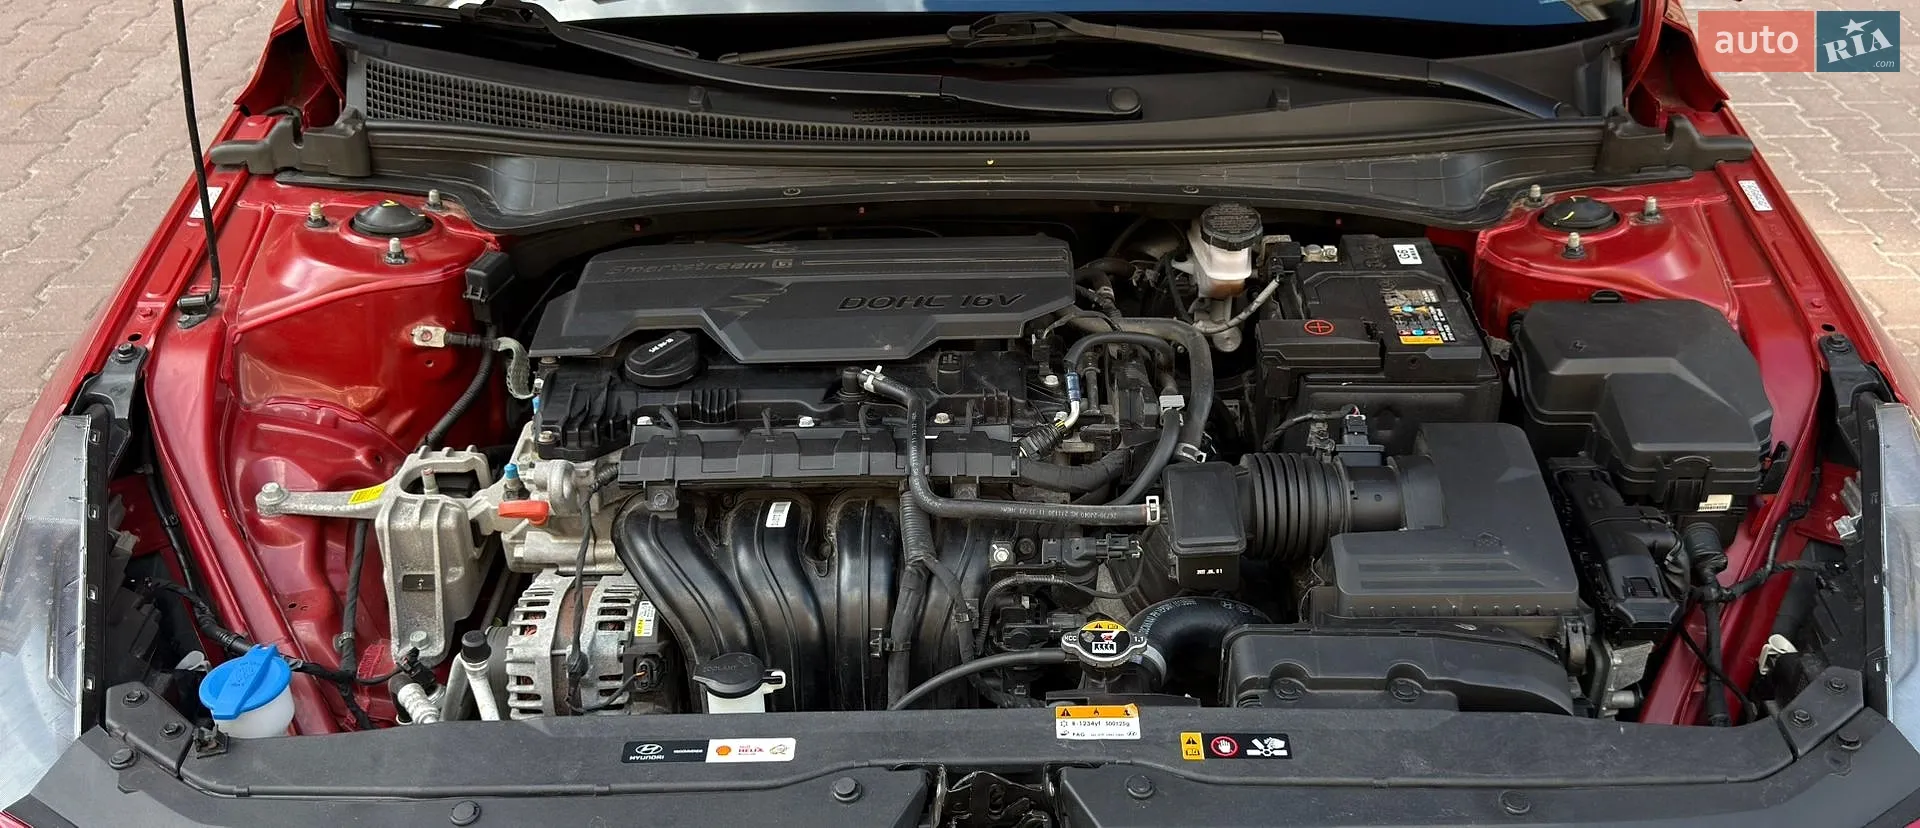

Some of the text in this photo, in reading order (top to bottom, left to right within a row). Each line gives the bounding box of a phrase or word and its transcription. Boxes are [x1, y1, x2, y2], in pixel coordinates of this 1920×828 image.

[605, 259, 767, 276] Smartstream
[837, 292, 1026, 312] DOHC 16V
